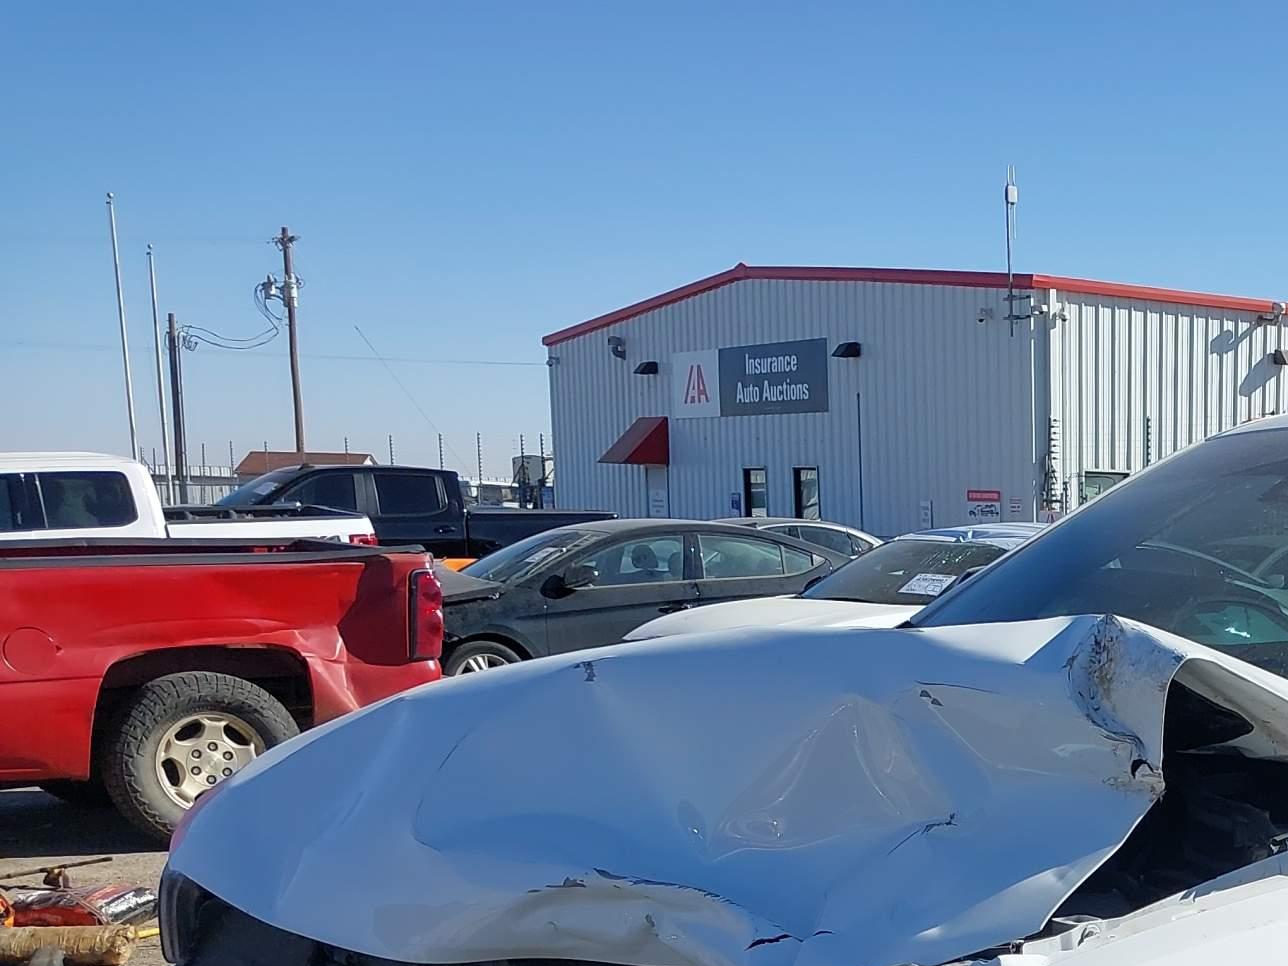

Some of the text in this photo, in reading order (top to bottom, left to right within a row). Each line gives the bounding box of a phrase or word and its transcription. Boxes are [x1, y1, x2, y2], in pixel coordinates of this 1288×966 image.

[745, 353, 798, 375] Insurance
[736, 379, 809, 404] Auto Auctions
